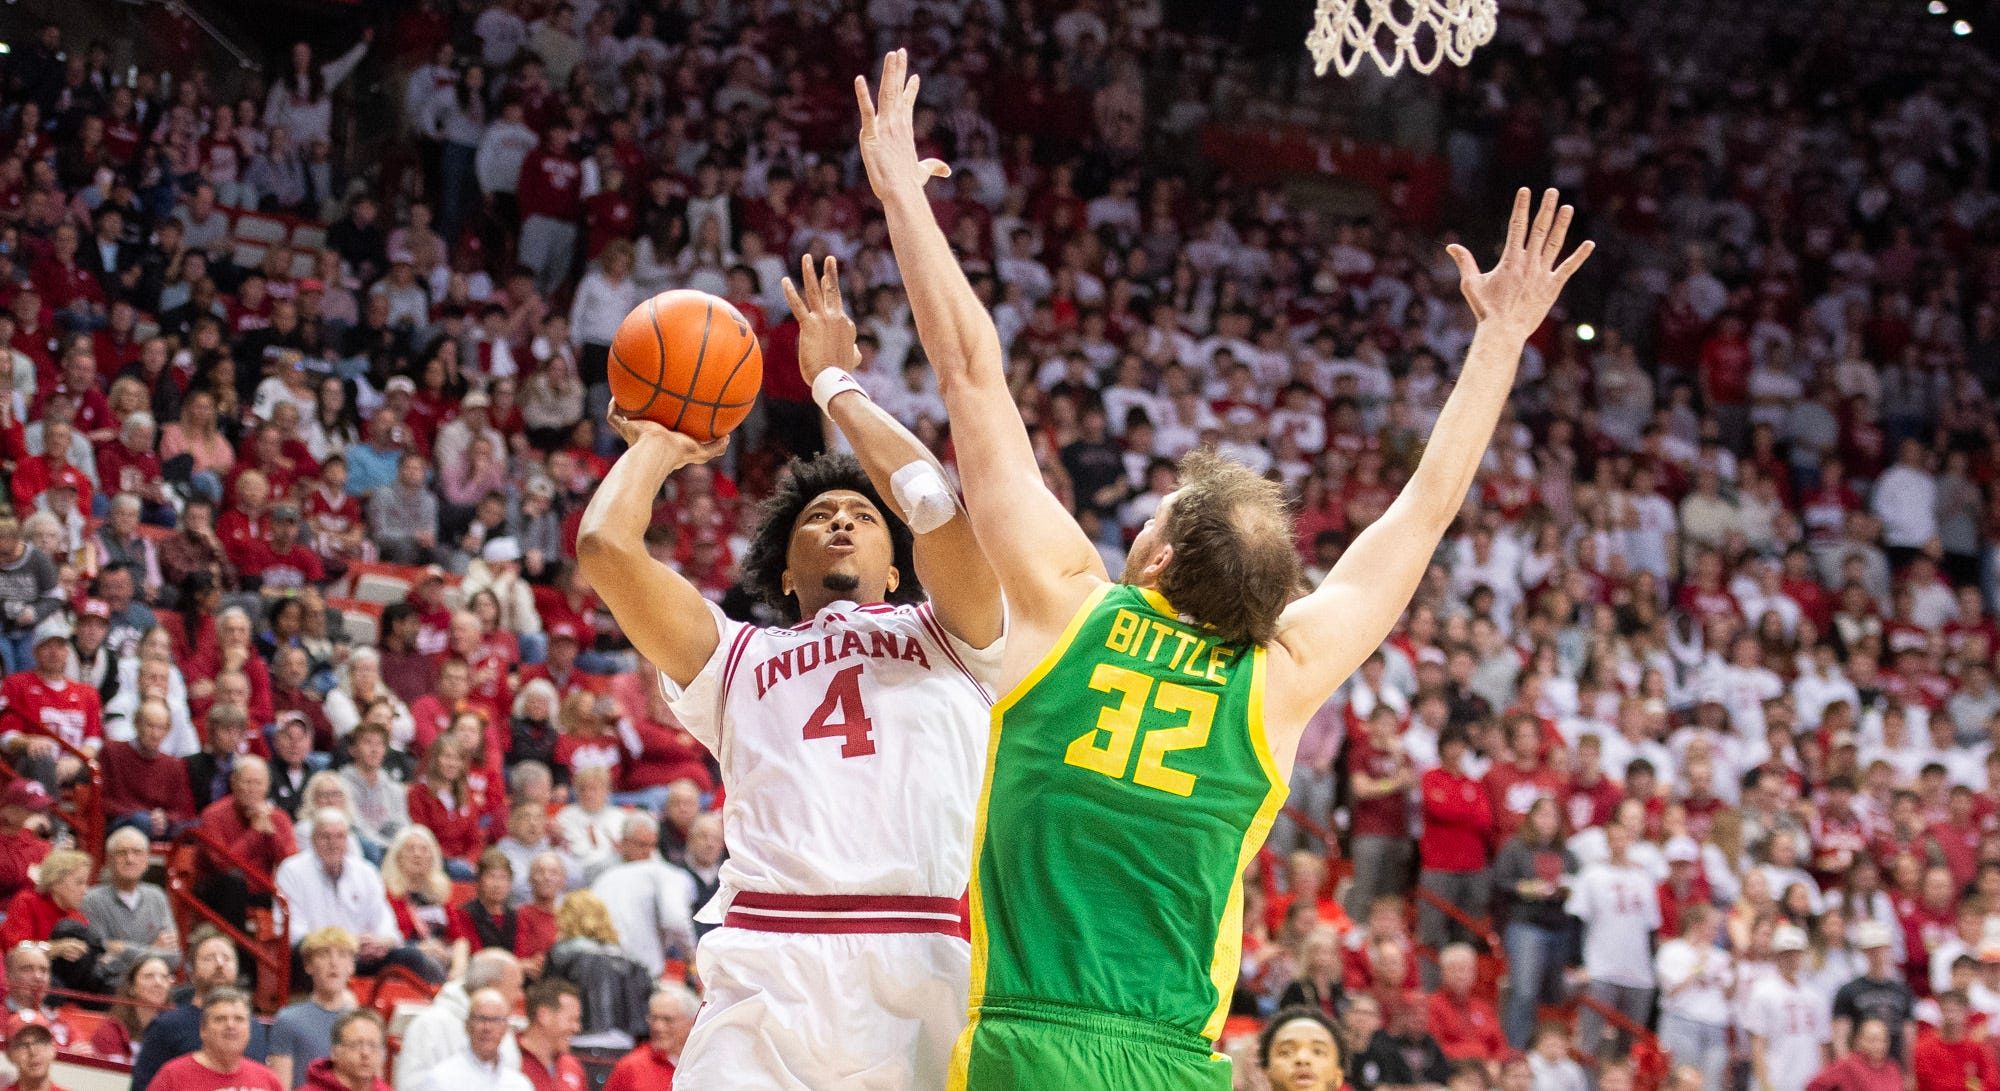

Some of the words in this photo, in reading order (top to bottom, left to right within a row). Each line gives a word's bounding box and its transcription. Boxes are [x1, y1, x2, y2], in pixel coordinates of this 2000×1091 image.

[753, 629, 932, 701] INDIANA
[1105, 607, 1235, 686] BITTLE
[802, 663, 876, 759] 4
[1063, 663, 1220, 798] 32
